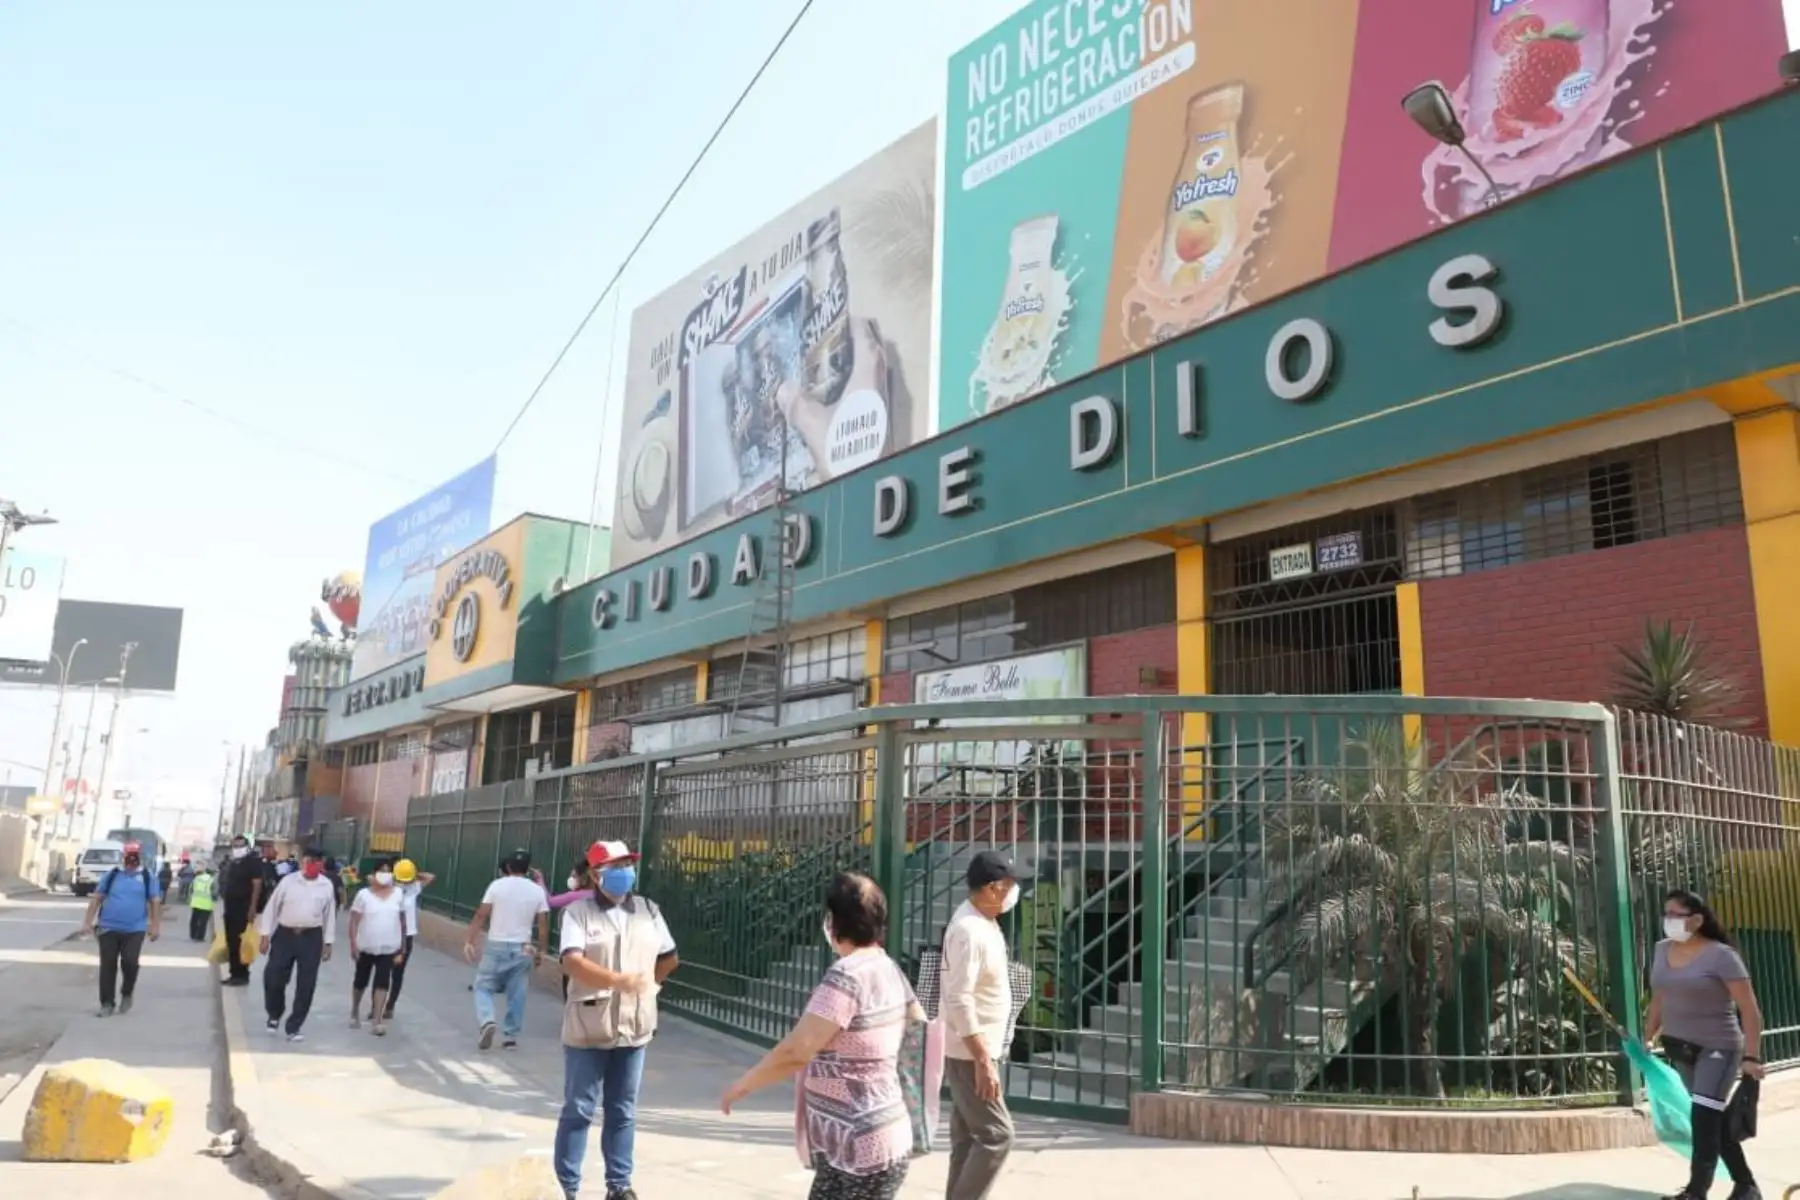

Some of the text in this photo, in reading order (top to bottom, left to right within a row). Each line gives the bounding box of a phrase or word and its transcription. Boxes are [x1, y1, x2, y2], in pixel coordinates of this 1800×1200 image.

[966, 0, 1193, 162] REFRIGERACIÓN
[967, 42, 1007, 110] NO
[1174, 167, 1240, 212] Yofresh
[684, 276, 741, 357] SHAKE
[749, 270, 758, 297] A
[762, 253, 778, 285] TU
[592, 511, 815, 630] CIUDAD
[873, 446, 977, 537] DE
[1070, 253, 1502, 470] DIOS
[1272, 551, 1310, 576] ENTRADA
[982, 664, 1021, 694] Belle
